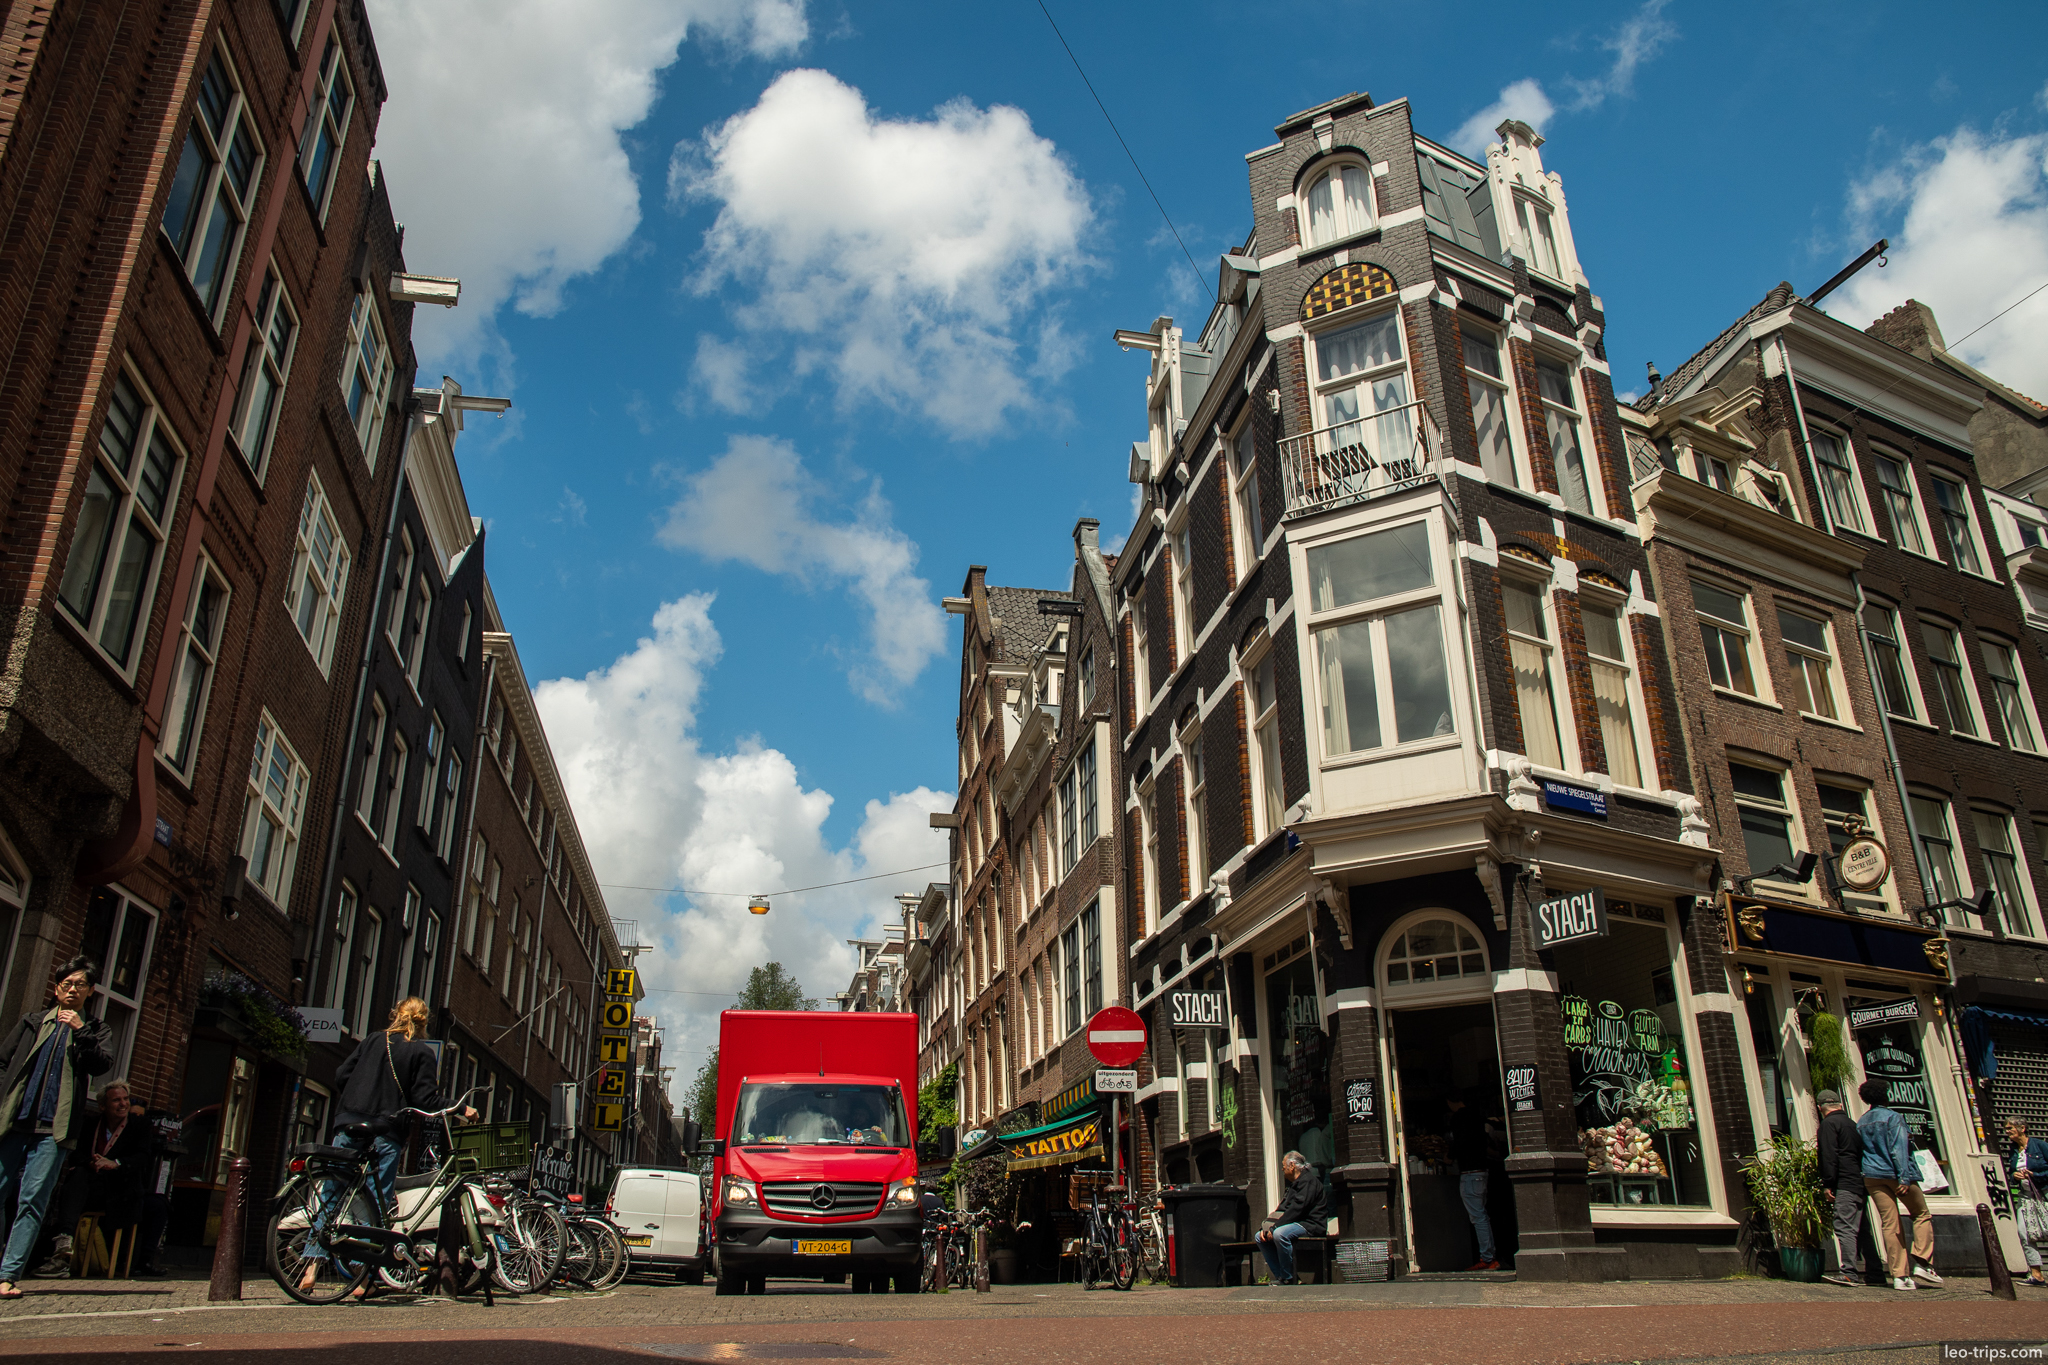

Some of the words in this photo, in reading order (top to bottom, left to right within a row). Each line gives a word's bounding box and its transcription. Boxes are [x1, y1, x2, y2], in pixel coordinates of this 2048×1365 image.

[1546, 783, 1568, 796] NIEUWE
[1568, 788, 1605, 803] SPIEGELSTRAAT
[1847, 861, 1866, 873] CENTRE
[1865, 856, 1878, 867] VILLE
[1850, 848, 1871, 862] B&B
[1539, 893, 1598, 941] STACH
[1172, 992, 1222, 1023] STACH
[1565, 1001, 1588, 1017] LAAG
[1851, 1010, 1884, 1025] GOURMET
[1885, 1002, 1919, 1017] BURGERS
[303, 1019, 339, 1031] VEDA
[1564, 1024, 1592, 1044] CARBS
[1597, 1017, 1630, 1049] HAVER
[596, 970, 633, 1129] HOTEL
[1636, 1033, 1661, 1053] ARM
[1866, 1047, 1891, 1065] PREMIUM
[1890, 1047, 1916, 1068] QUALITY
[1506, 1068, 1536, 1086] SAND
[1026, 1123, 1098, 1156] TATTOO
[801, 1242, 847, 1253] VT-204-G
